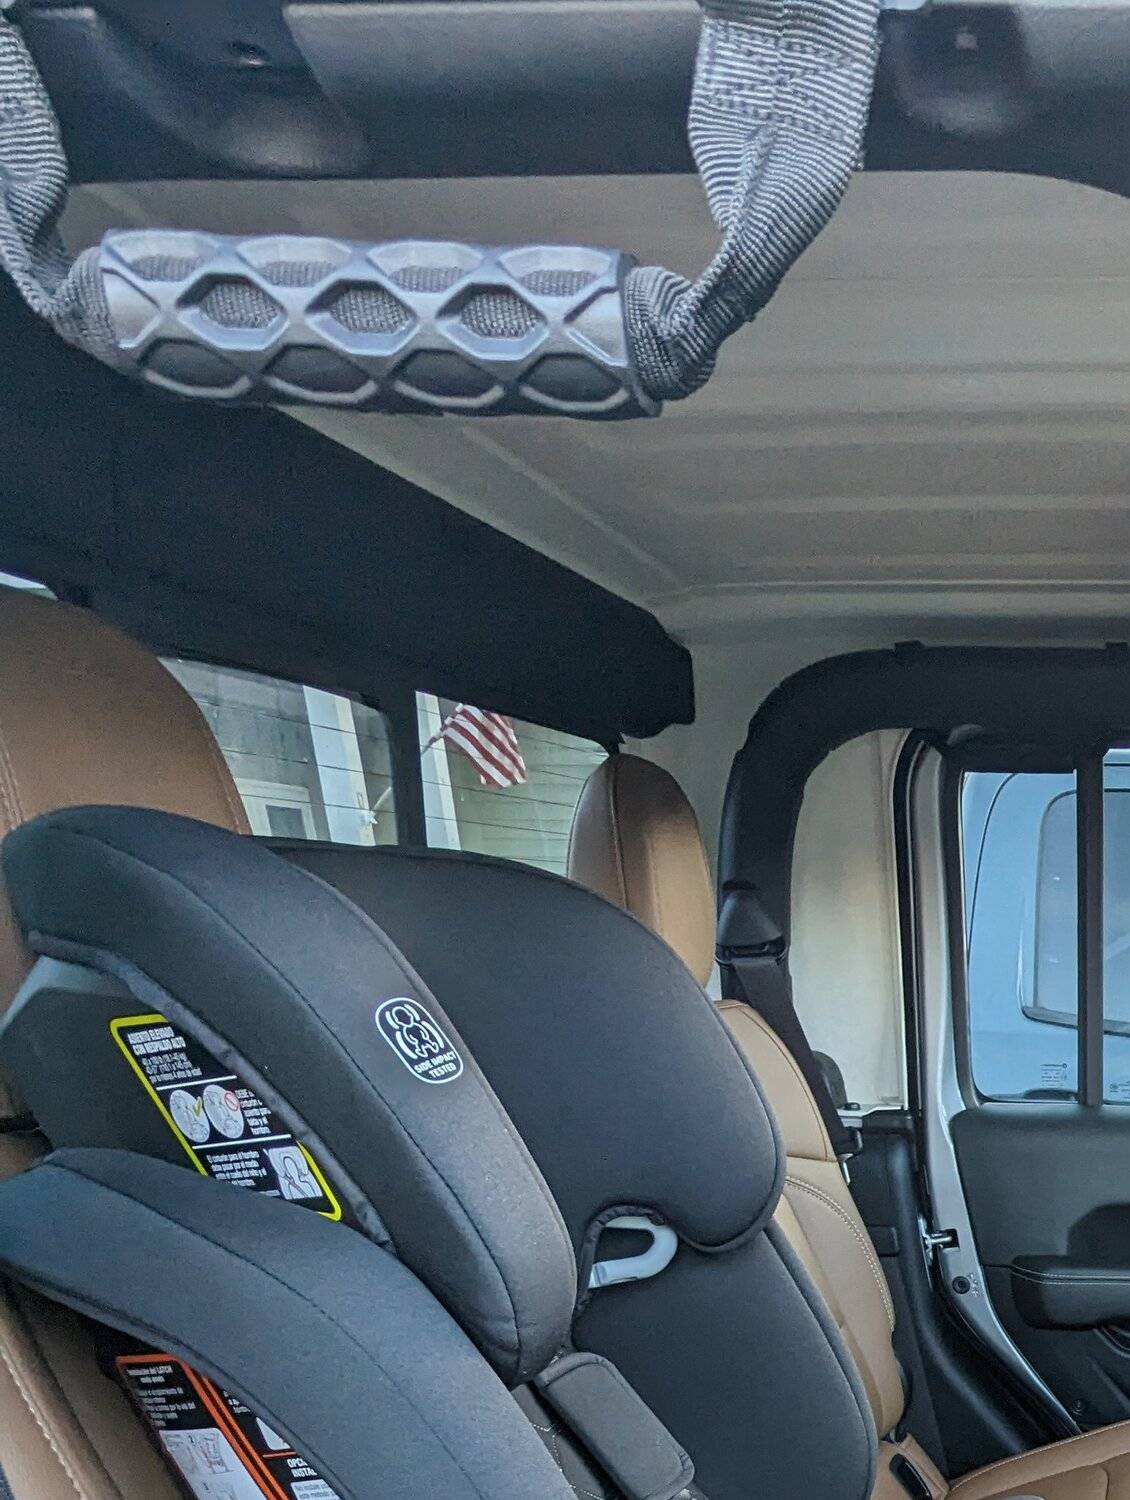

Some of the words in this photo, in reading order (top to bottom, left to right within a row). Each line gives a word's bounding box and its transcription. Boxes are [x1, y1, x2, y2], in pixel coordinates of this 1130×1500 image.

[414, 1060, 433, 1074] SIDE
[431, 1051, 456, 1066] IMPACT
[429, 1062, 456, 1078] TESTED
